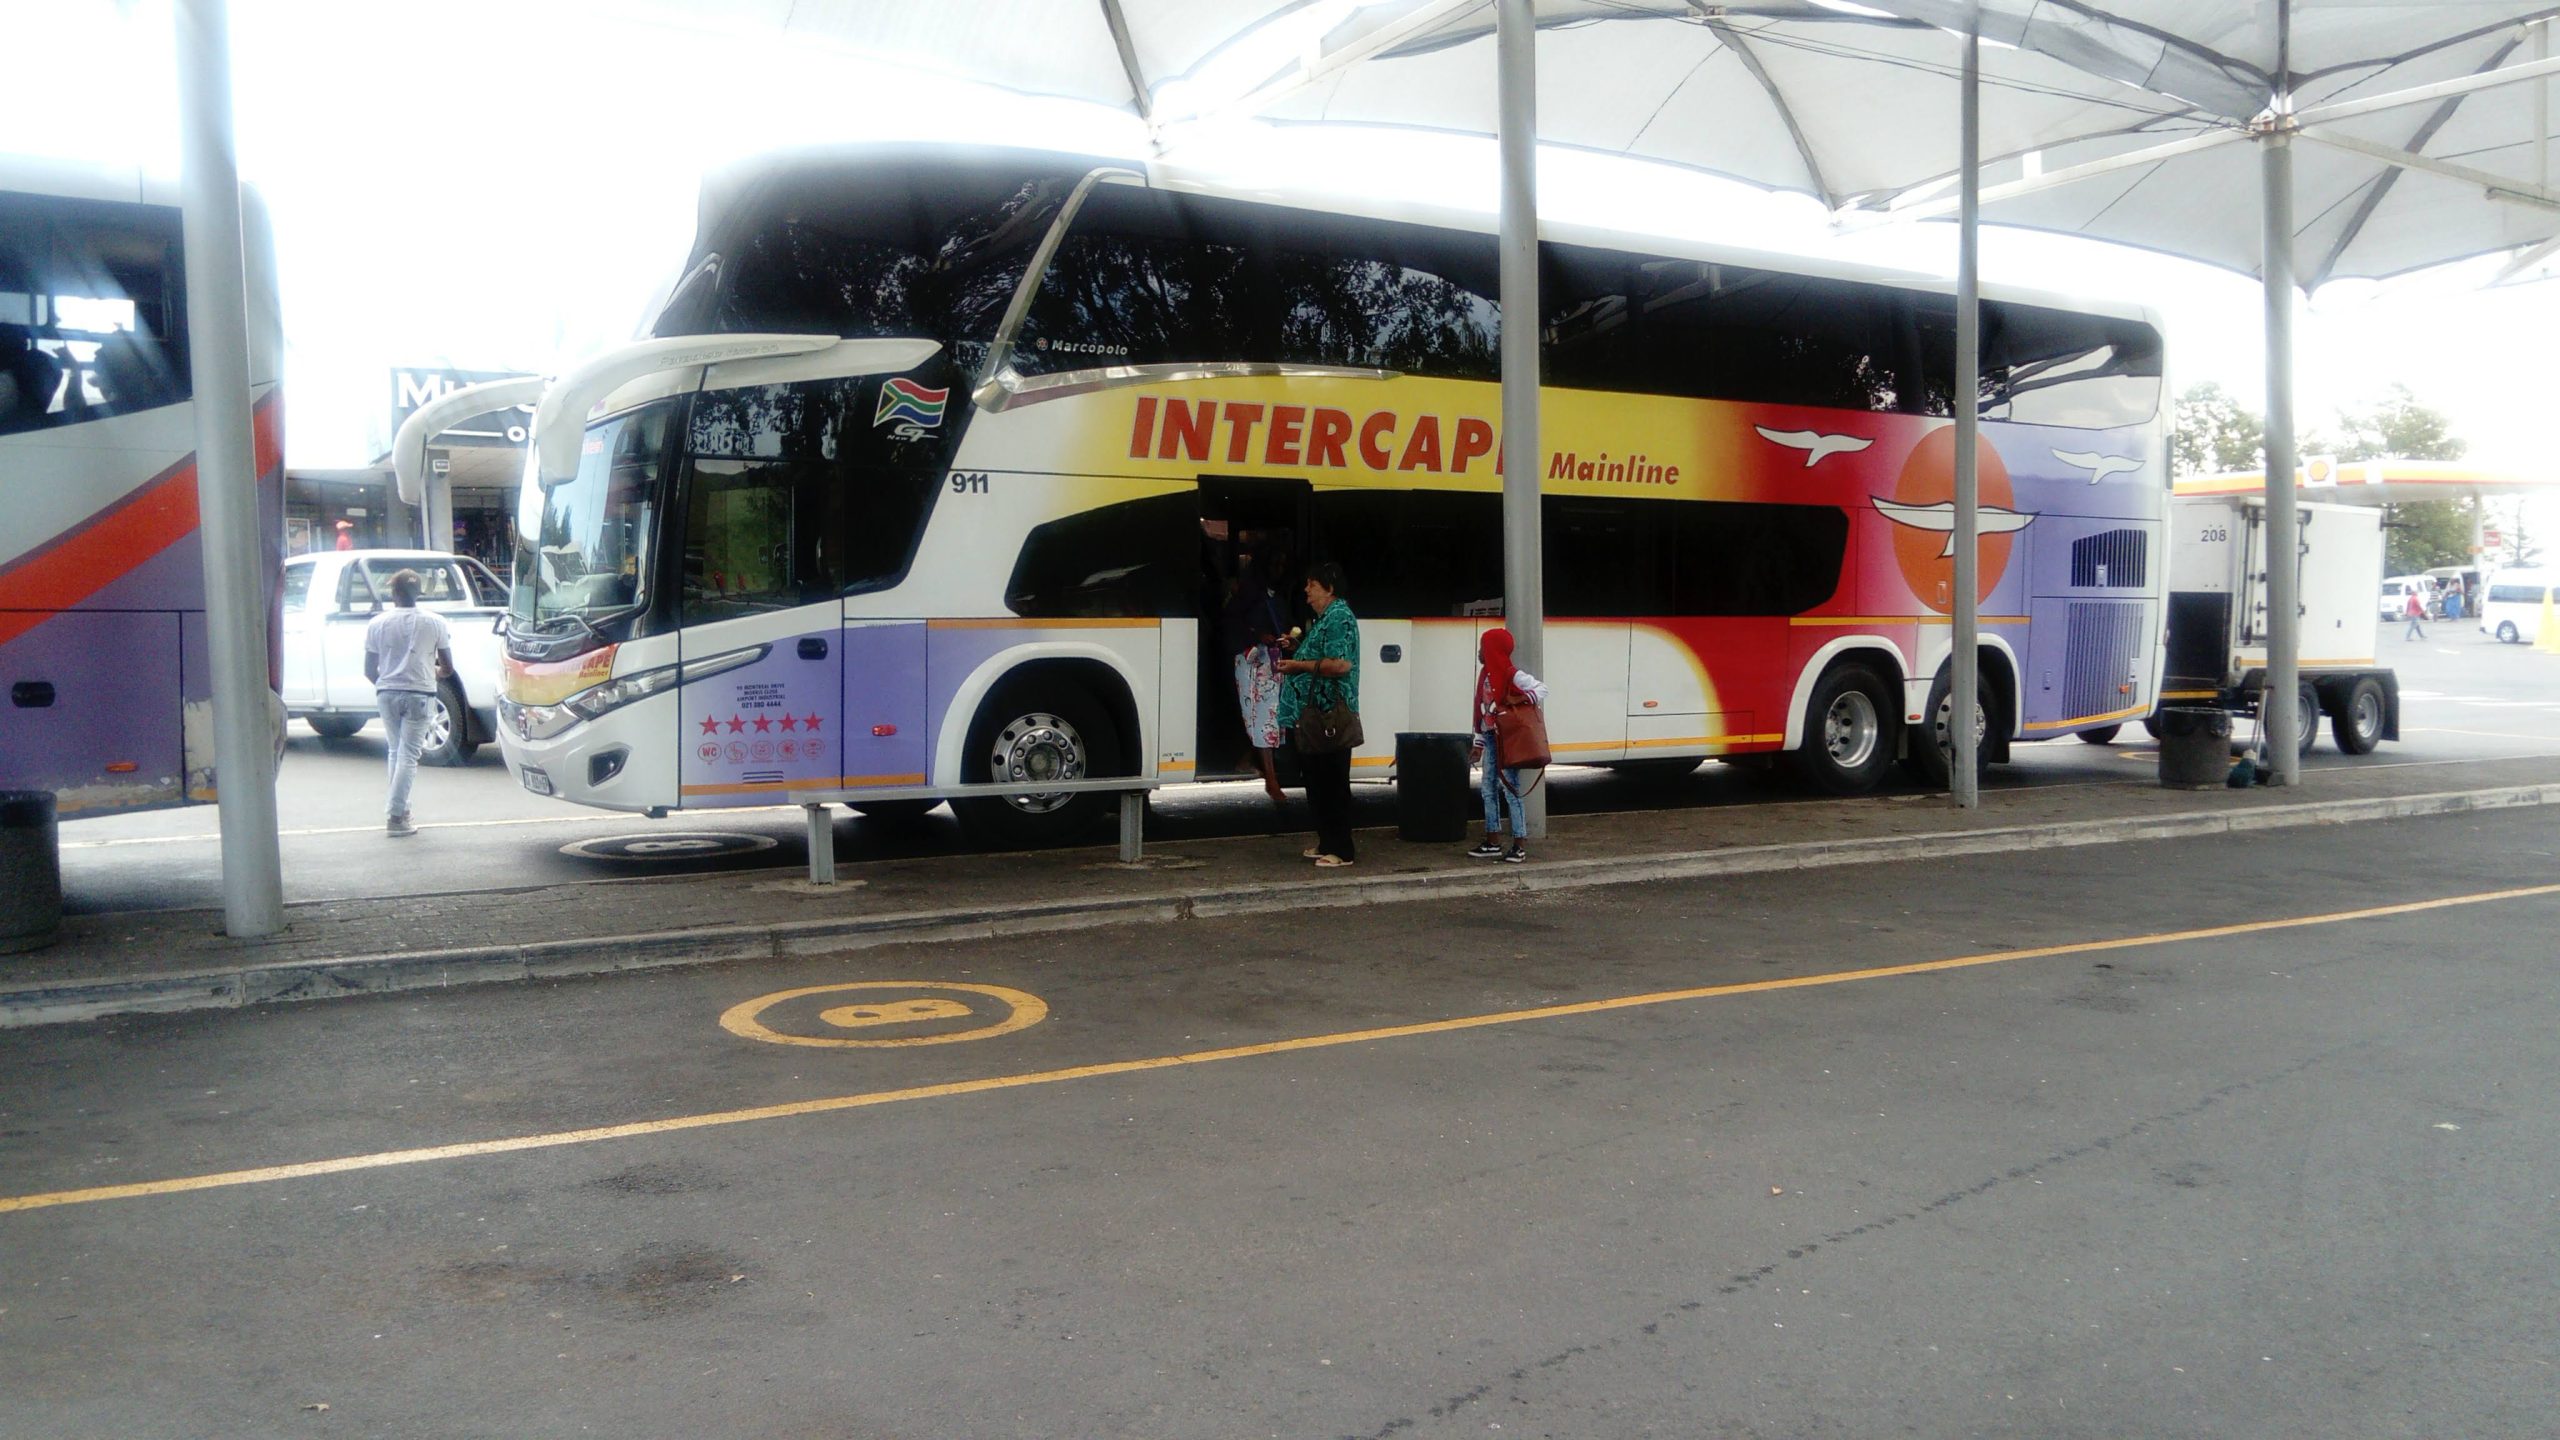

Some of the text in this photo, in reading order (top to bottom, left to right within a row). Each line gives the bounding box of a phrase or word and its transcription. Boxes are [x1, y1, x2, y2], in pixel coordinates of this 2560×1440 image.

[1051, 339, 1128, 356] Marcopolo
[1128, 396, 1680, 486] INTERCAP Mainline
[952, 473, 989, 494] 911
[2200, 529, 2227, 542] 208
[702, 747, 717, 757] WC
